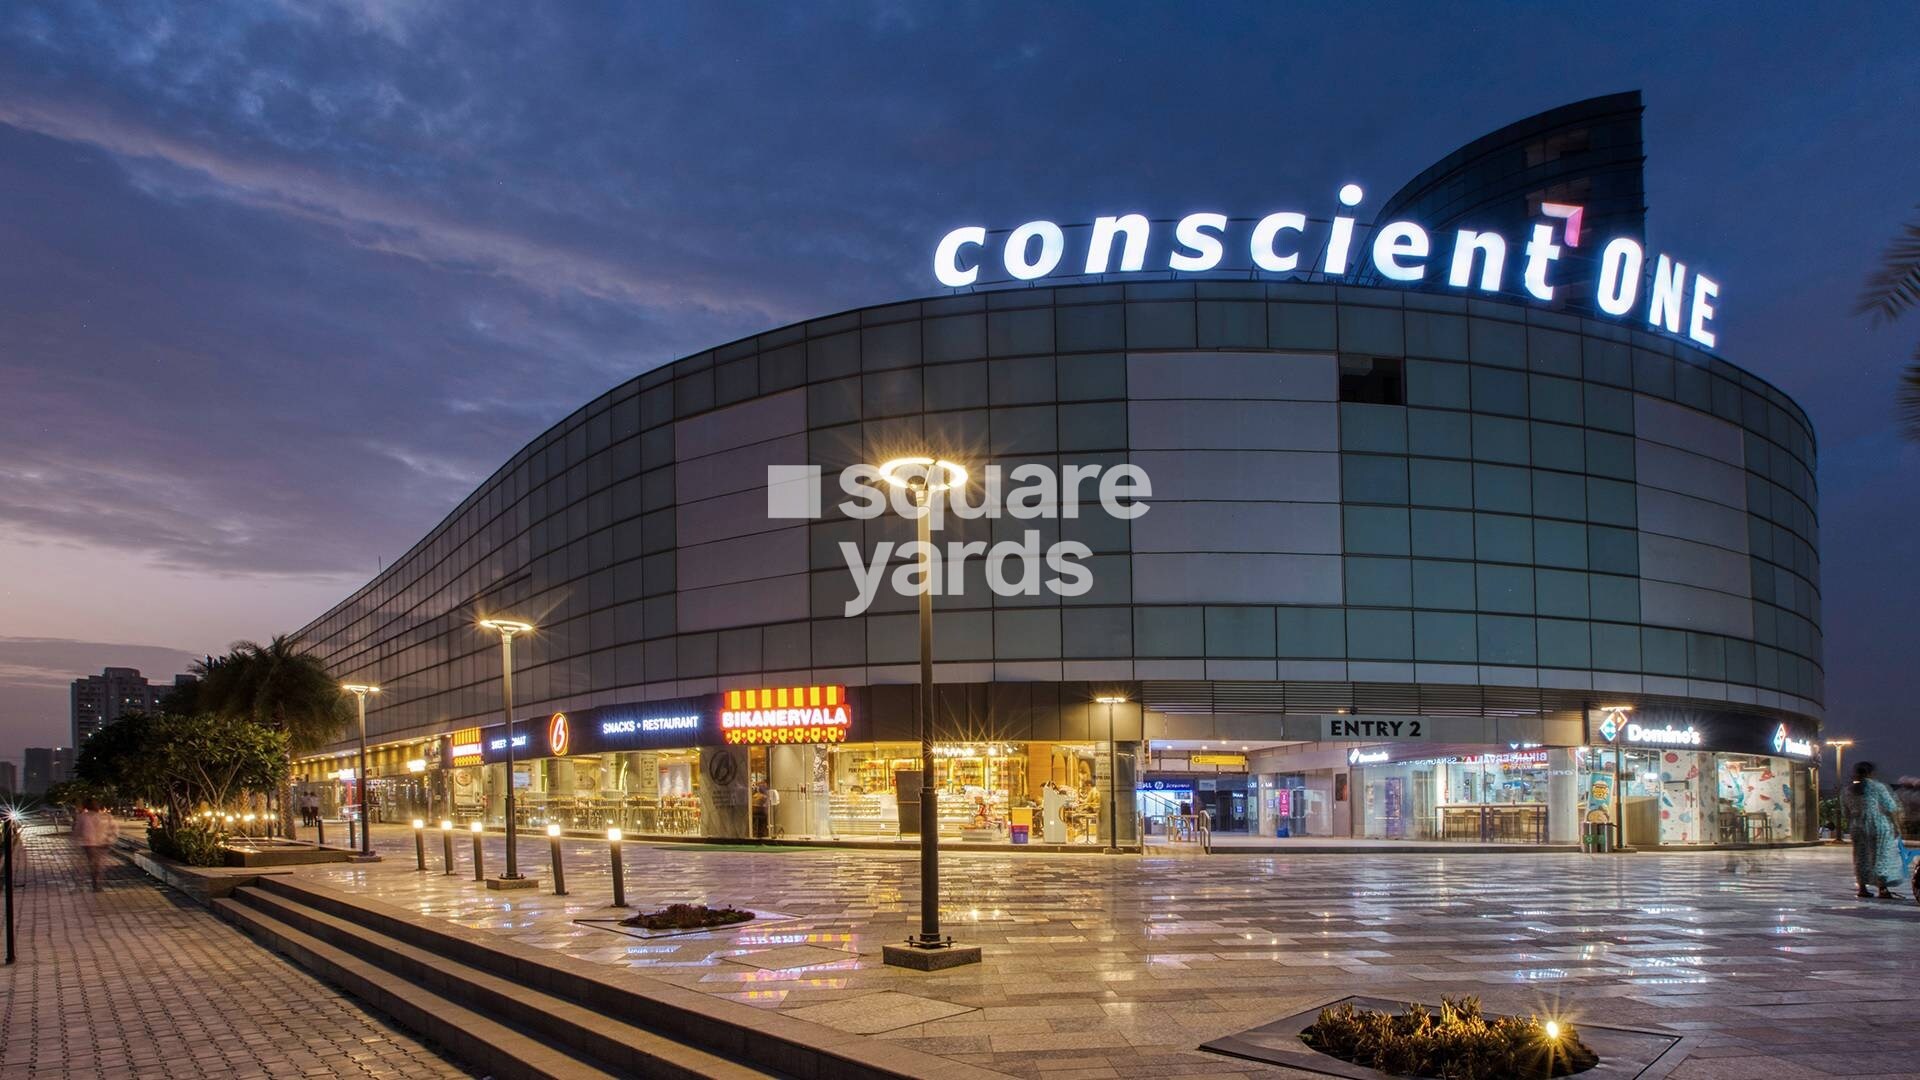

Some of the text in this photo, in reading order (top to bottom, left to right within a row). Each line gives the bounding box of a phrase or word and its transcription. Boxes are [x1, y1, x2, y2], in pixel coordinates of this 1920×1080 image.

[934, 183, 1720, 348] conscient ONE
[603, 715, 699, 734] SNACKS RESTAURANT
[722, 708, 847, 727] BIKANERVALA
[1331, 720, 1422, 737] ENTRY 2
[1628, 724, 1701, 745] Domino's
